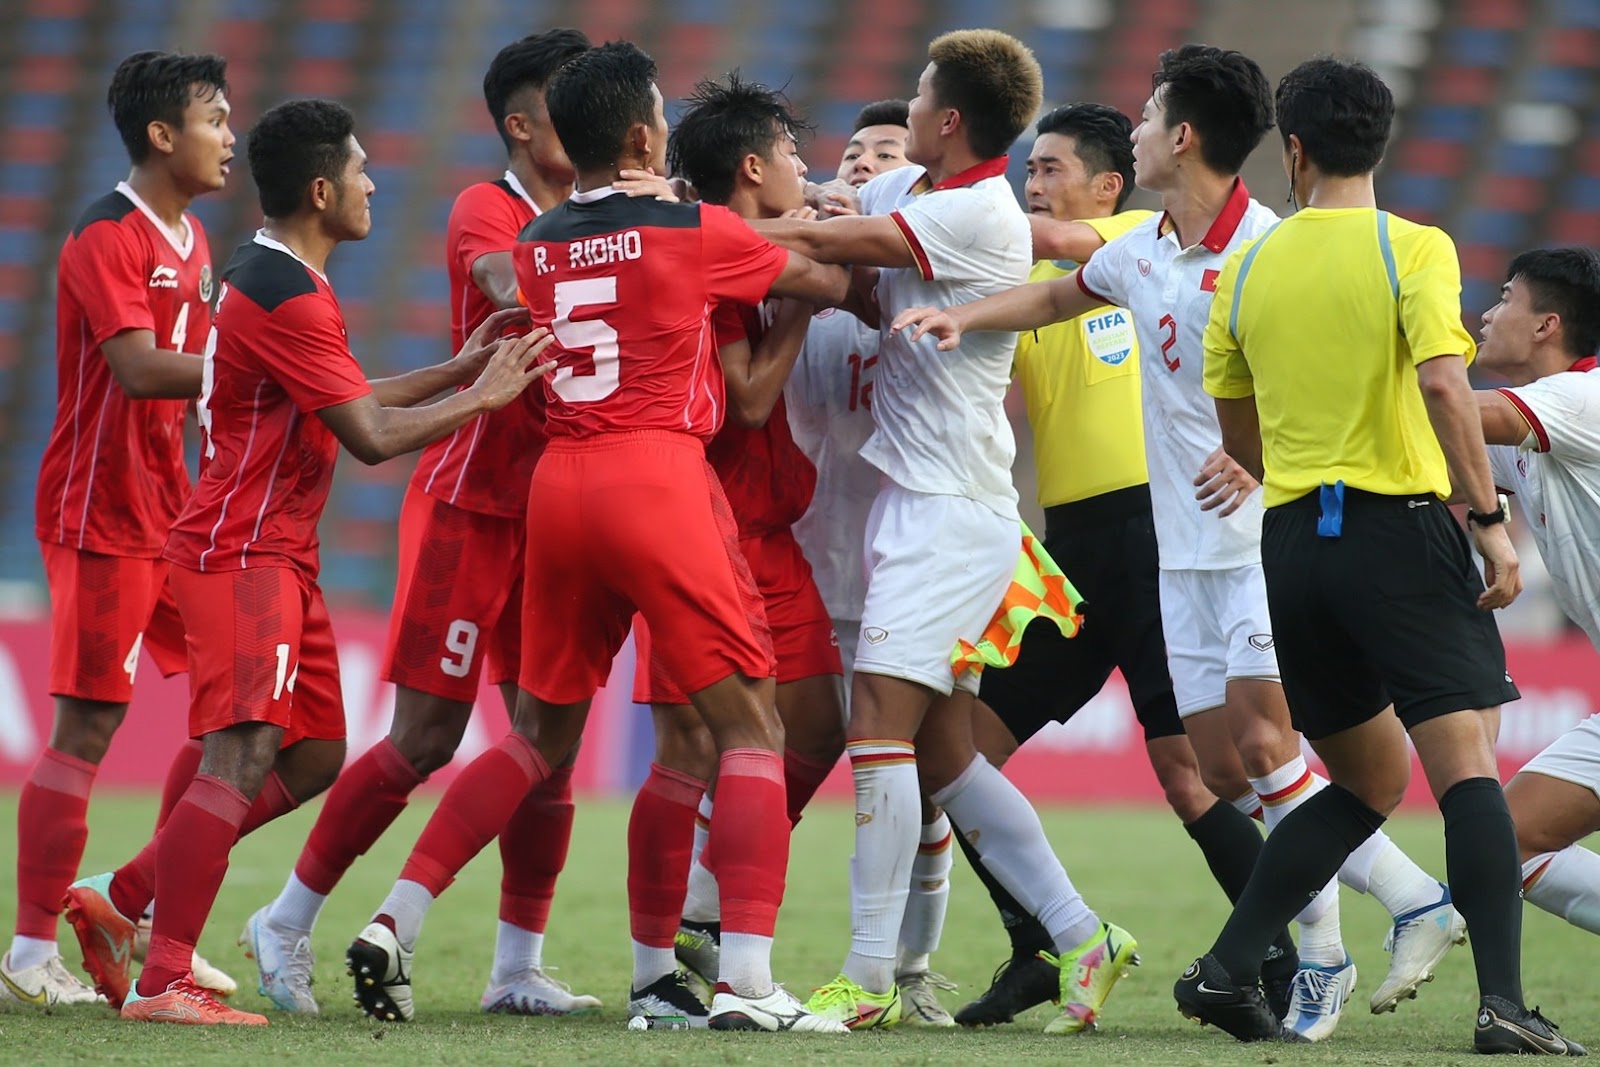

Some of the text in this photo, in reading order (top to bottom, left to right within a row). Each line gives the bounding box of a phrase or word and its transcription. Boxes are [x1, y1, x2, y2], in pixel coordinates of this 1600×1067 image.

[534, 229, 643, 276] R. RIDHO
[171, 302, 190, 354] 4
[551, 276, 621, 403] 5
[1087, 312, 1127, 334] FIFA
[1159, 313, 1181, 373] 2
[1106, 352, 1126, 363] 2023
[123, 631, 144, 685] 4
[440, 619, 479, 678] 9
